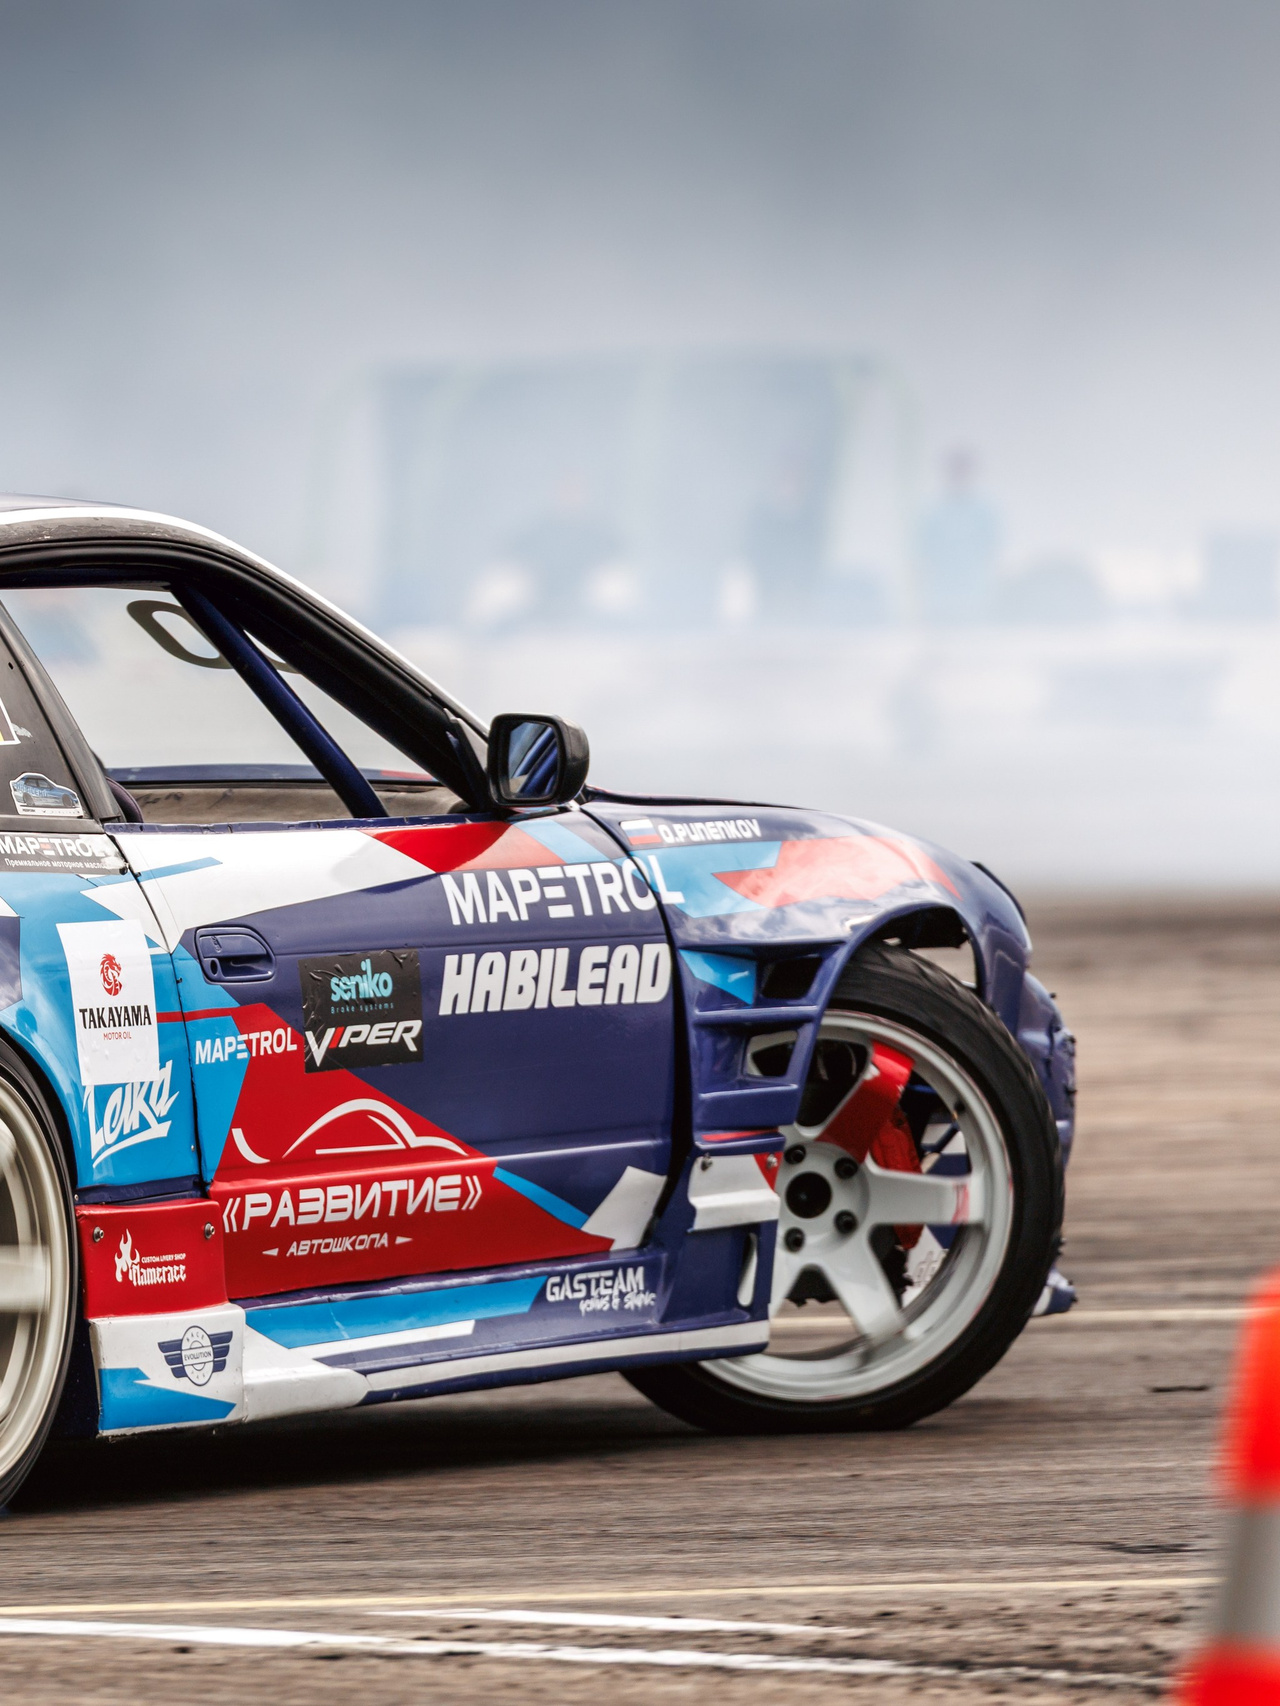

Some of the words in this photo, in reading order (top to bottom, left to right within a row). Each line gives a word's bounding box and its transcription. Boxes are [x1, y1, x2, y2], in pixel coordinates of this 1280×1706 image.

[4, 858, 51, 869] Премиальное
[51, 860, 84, 869] моторное
[440, 855, 685, 925] MAPETROL
[330, 958, 393, 1002] seniko
[439, 943, 671, 1015] HABILEAD
[79, 1005, 152, 1029] TAKAYAMA
[330, 1006, 355, 1015] Brake
[360, 1002, 394, 1013] systems
[103, 1032, 122, 1041] MOTOR
[123, 1032, 132, 1040] OIL
[195, 1027, 297, 1065] MAPETROL
[305, 1020, 423, 1067] VIPER
[286, 1232, 389, 1257] АВТОШКОЛА
[546, 1266, 644, 1302] GASTEAM
[183, 1350, 212, 1361] EVOLUTION
